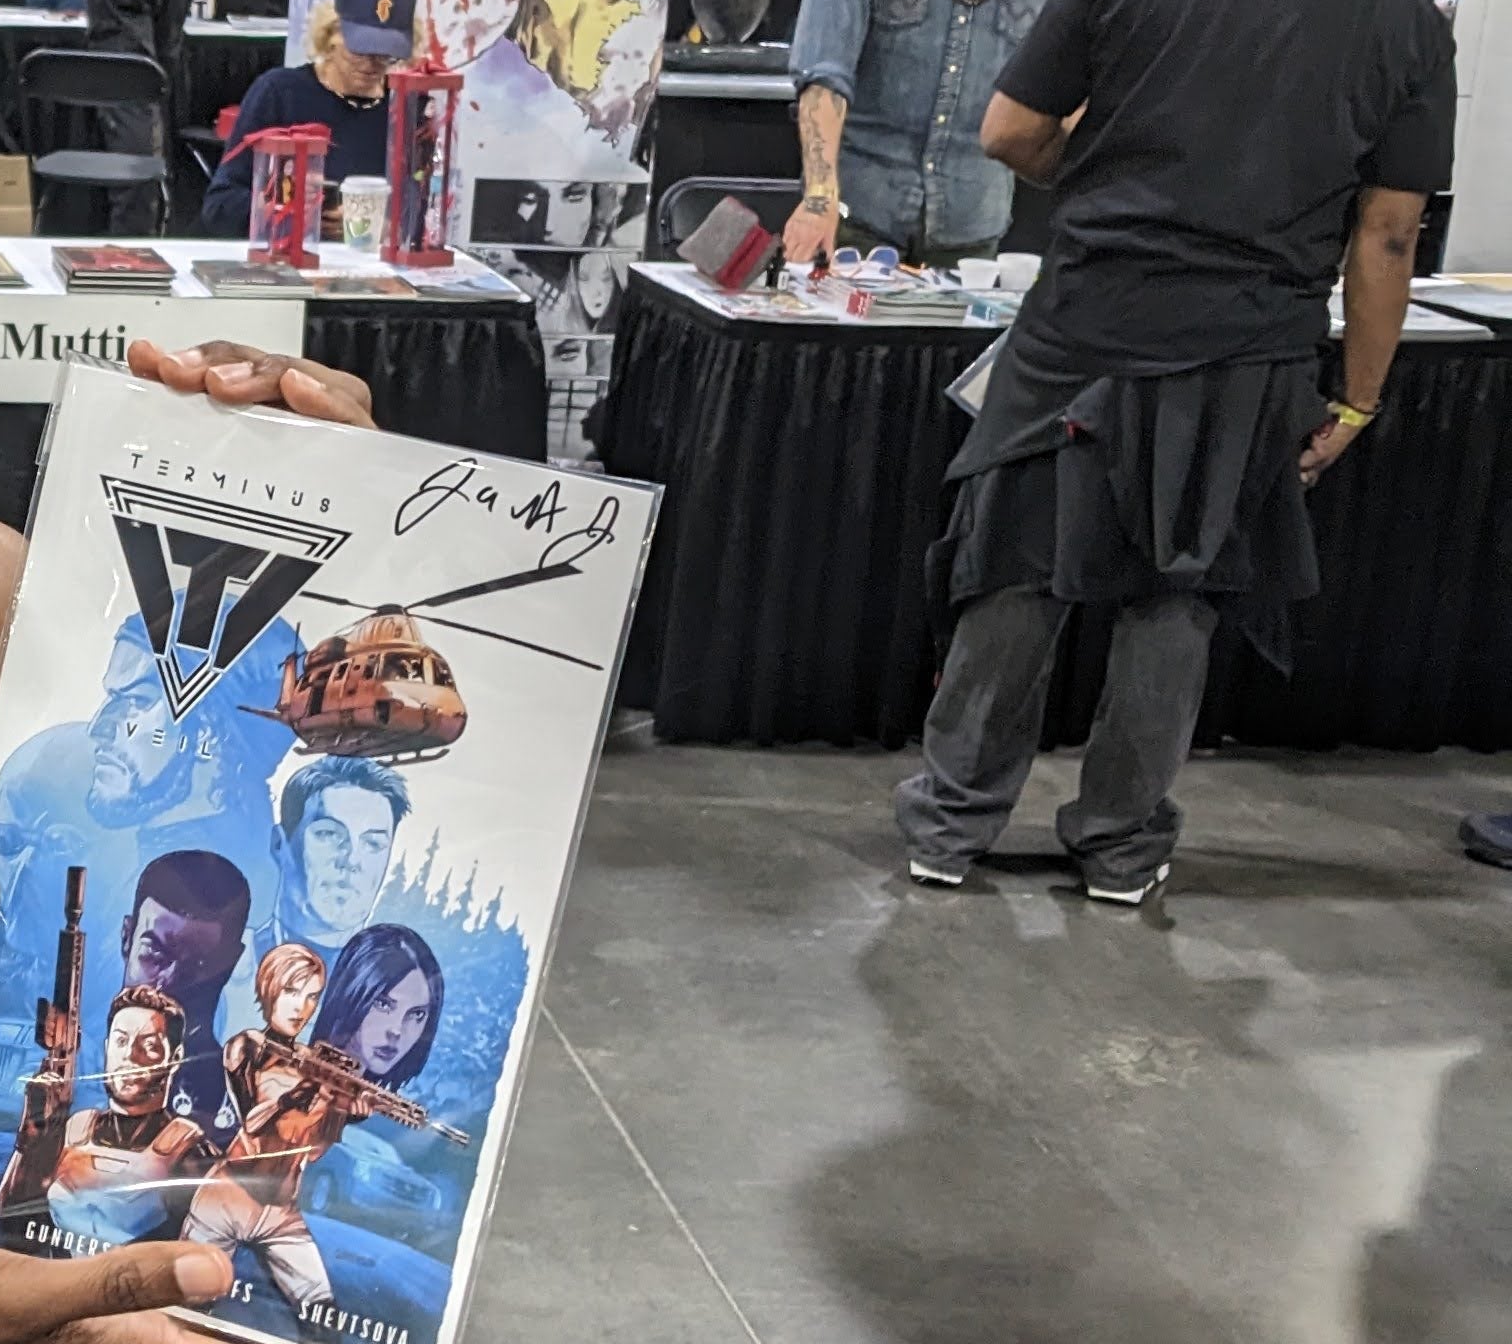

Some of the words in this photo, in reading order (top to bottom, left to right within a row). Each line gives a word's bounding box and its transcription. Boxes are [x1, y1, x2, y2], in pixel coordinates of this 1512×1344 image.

[0, 323, 128, 361] Mutti
[130, 453, 332, 514] TERMINUS
[126, 722, 212, 759] VEIL
